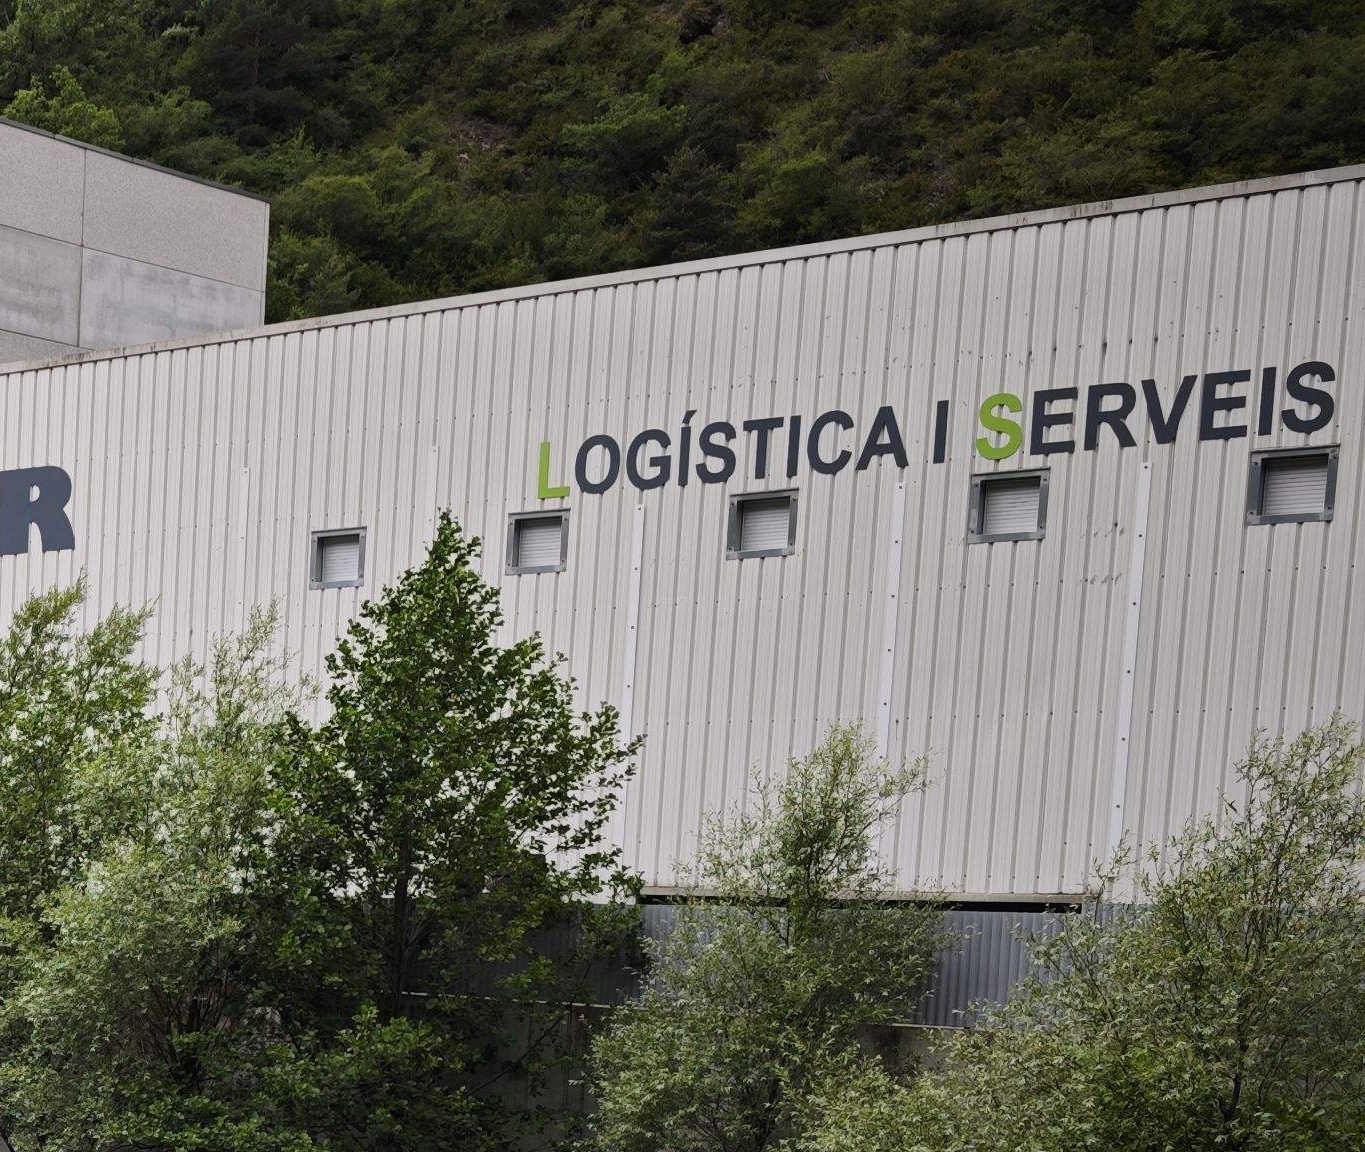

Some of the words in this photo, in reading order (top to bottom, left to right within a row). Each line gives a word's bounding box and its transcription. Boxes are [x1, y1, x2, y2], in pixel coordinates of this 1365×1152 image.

[537, 405, 909, 499] LOGÍSTICA
[934, 399, 950, 464] I
[976, 361, 1337, 460] SERVEIS
